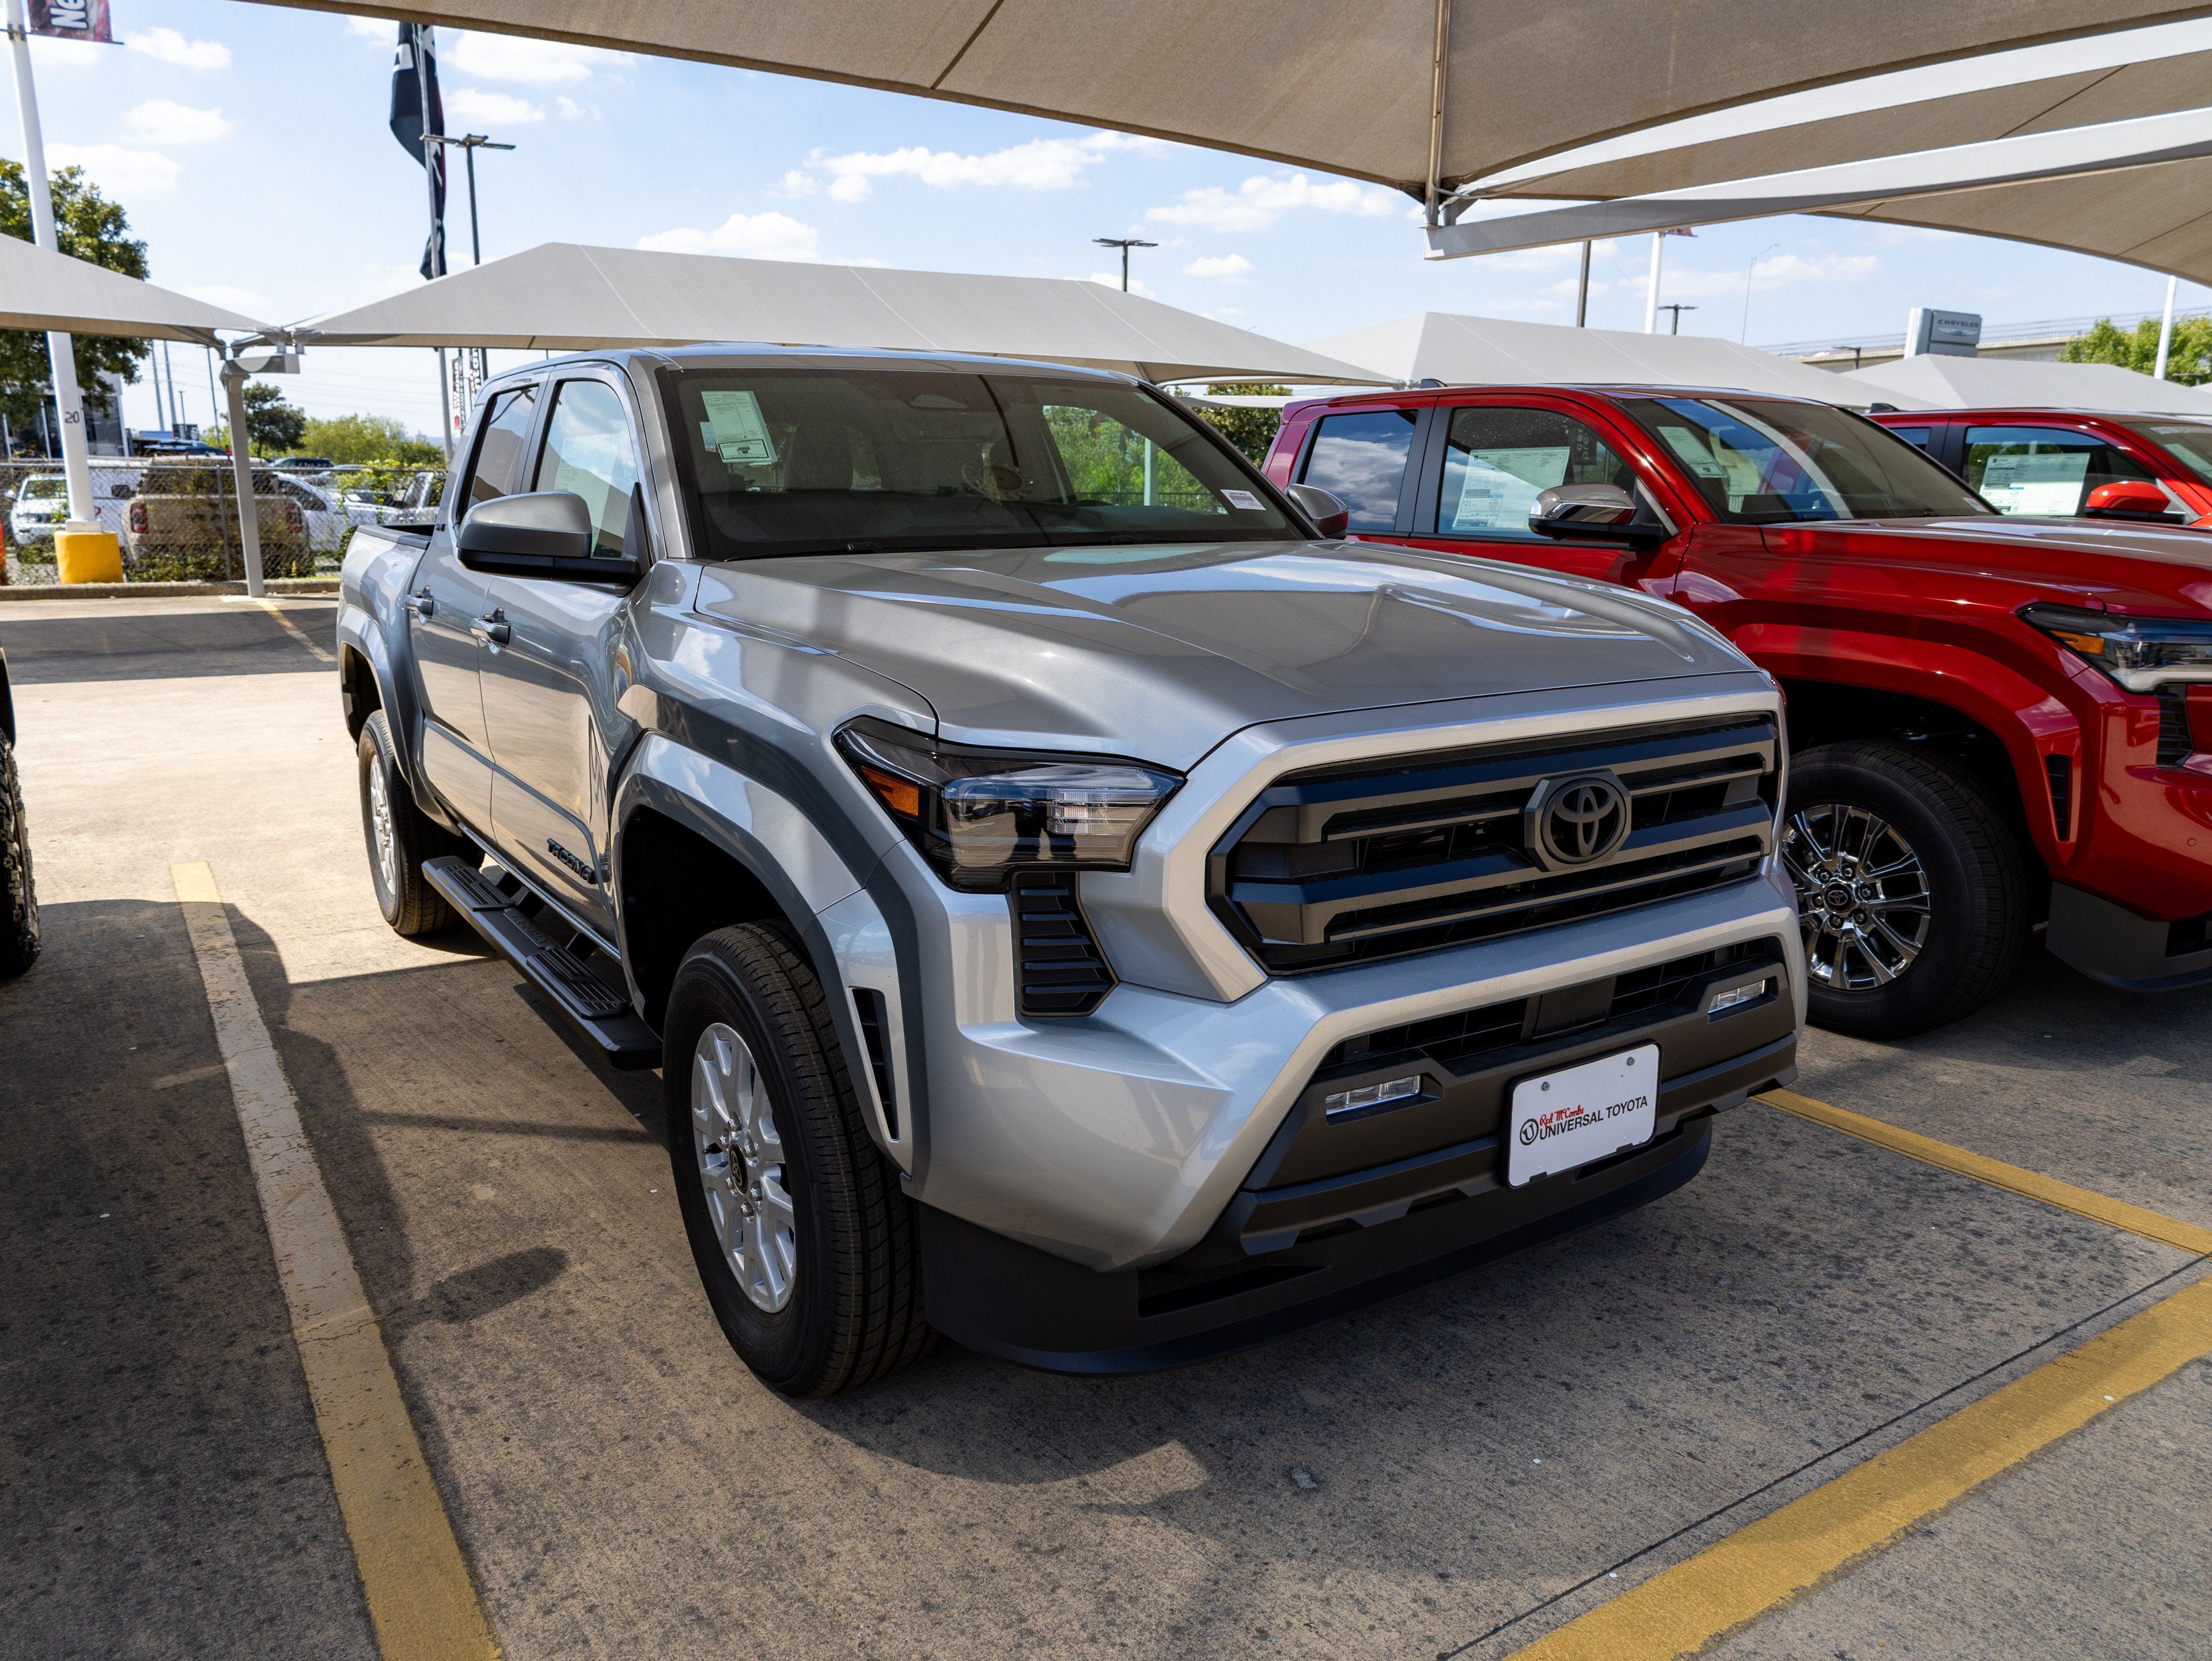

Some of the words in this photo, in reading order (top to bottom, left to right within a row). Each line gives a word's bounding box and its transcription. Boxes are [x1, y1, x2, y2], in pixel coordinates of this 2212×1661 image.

[1938, 319, 1979, 328] CHRYSLER
[65, 411, 79, 423] 20
[547, 838, 597, 884] TACOMA
[1539, 1112, 1554, 1129] Red
[1554, 1104, 1584, 1122] McCombs
[1540, 1110, 1604, 1140] UNIVERSAL
[1605, 1095, 1648, 1118] TOYOTA
